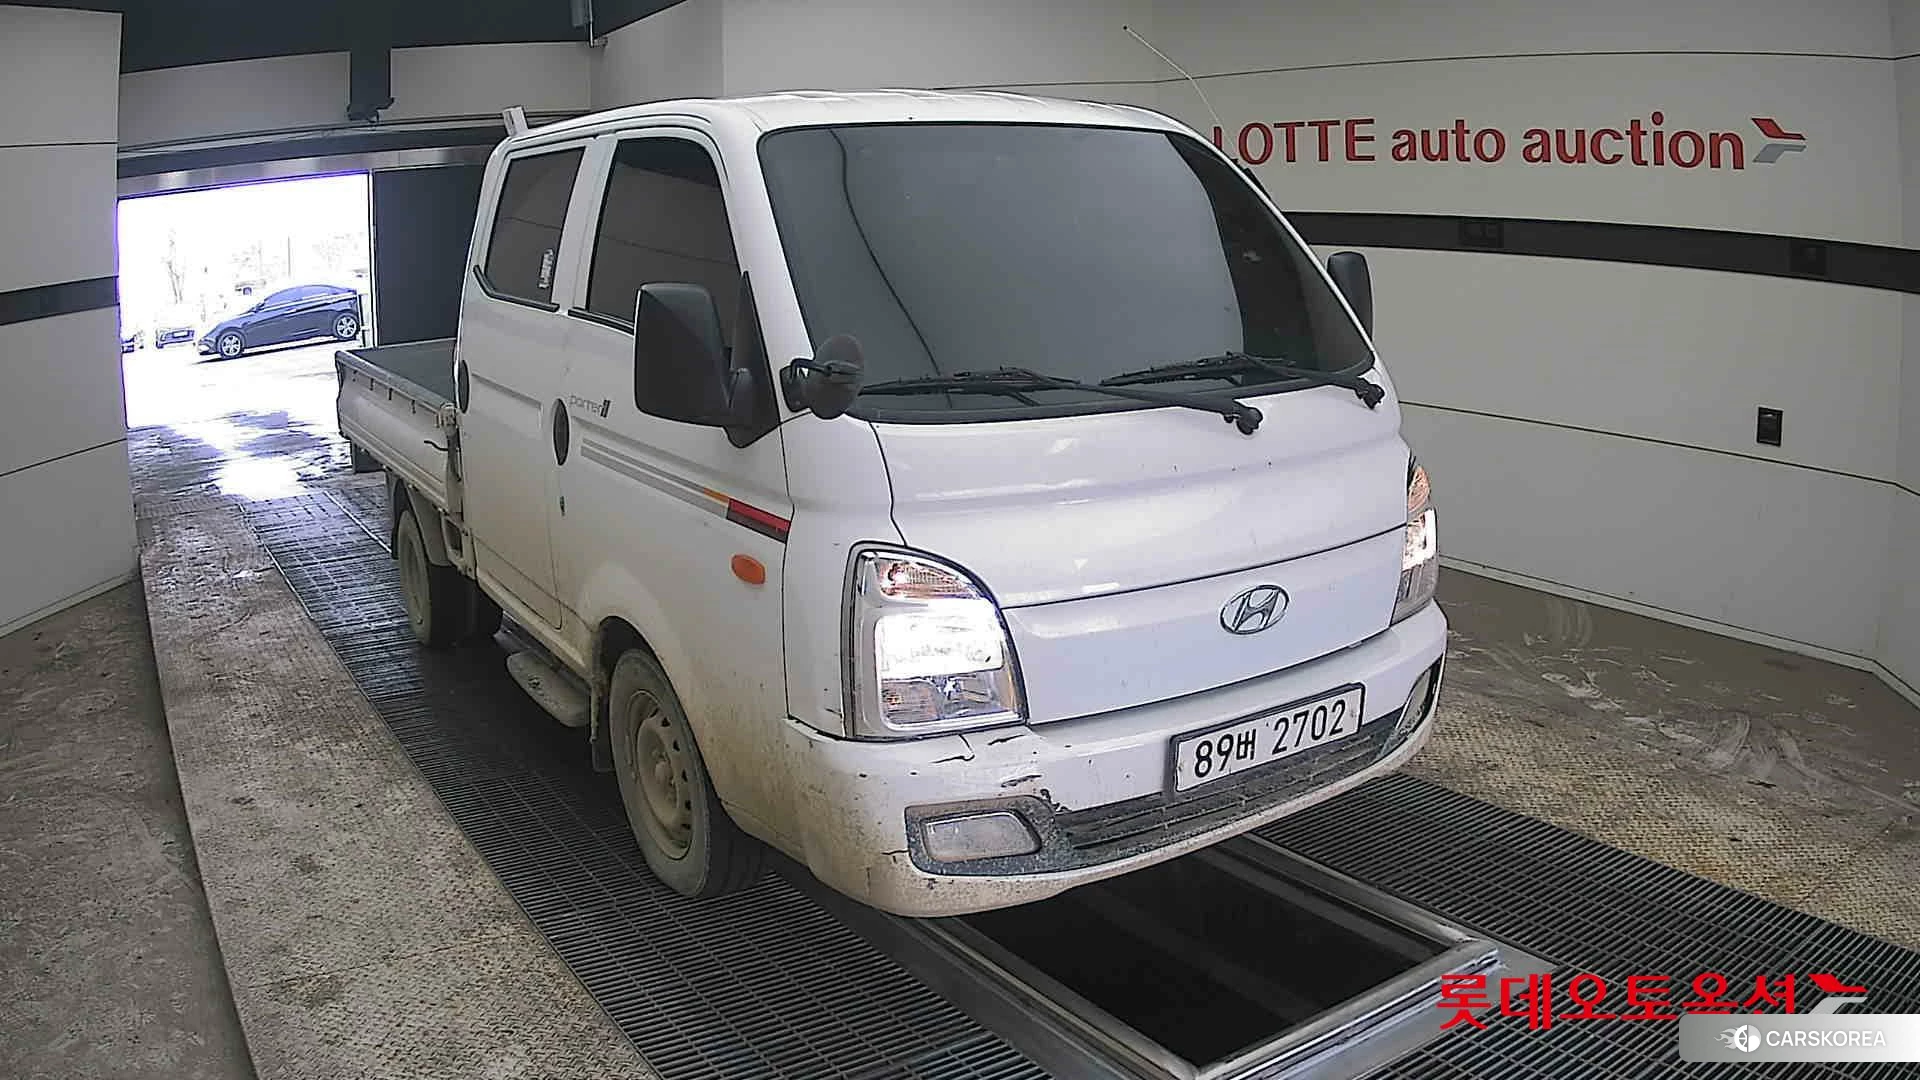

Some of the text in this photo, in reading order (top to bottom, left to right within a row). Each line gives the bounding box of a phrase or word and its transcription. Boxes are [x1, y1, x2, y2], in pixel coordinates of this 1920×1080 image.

[1391, 118, 1506, 164] auto
[1522, 111, 1745, 170] auction
[1193, 699, 1347, 778] 89버 2702
